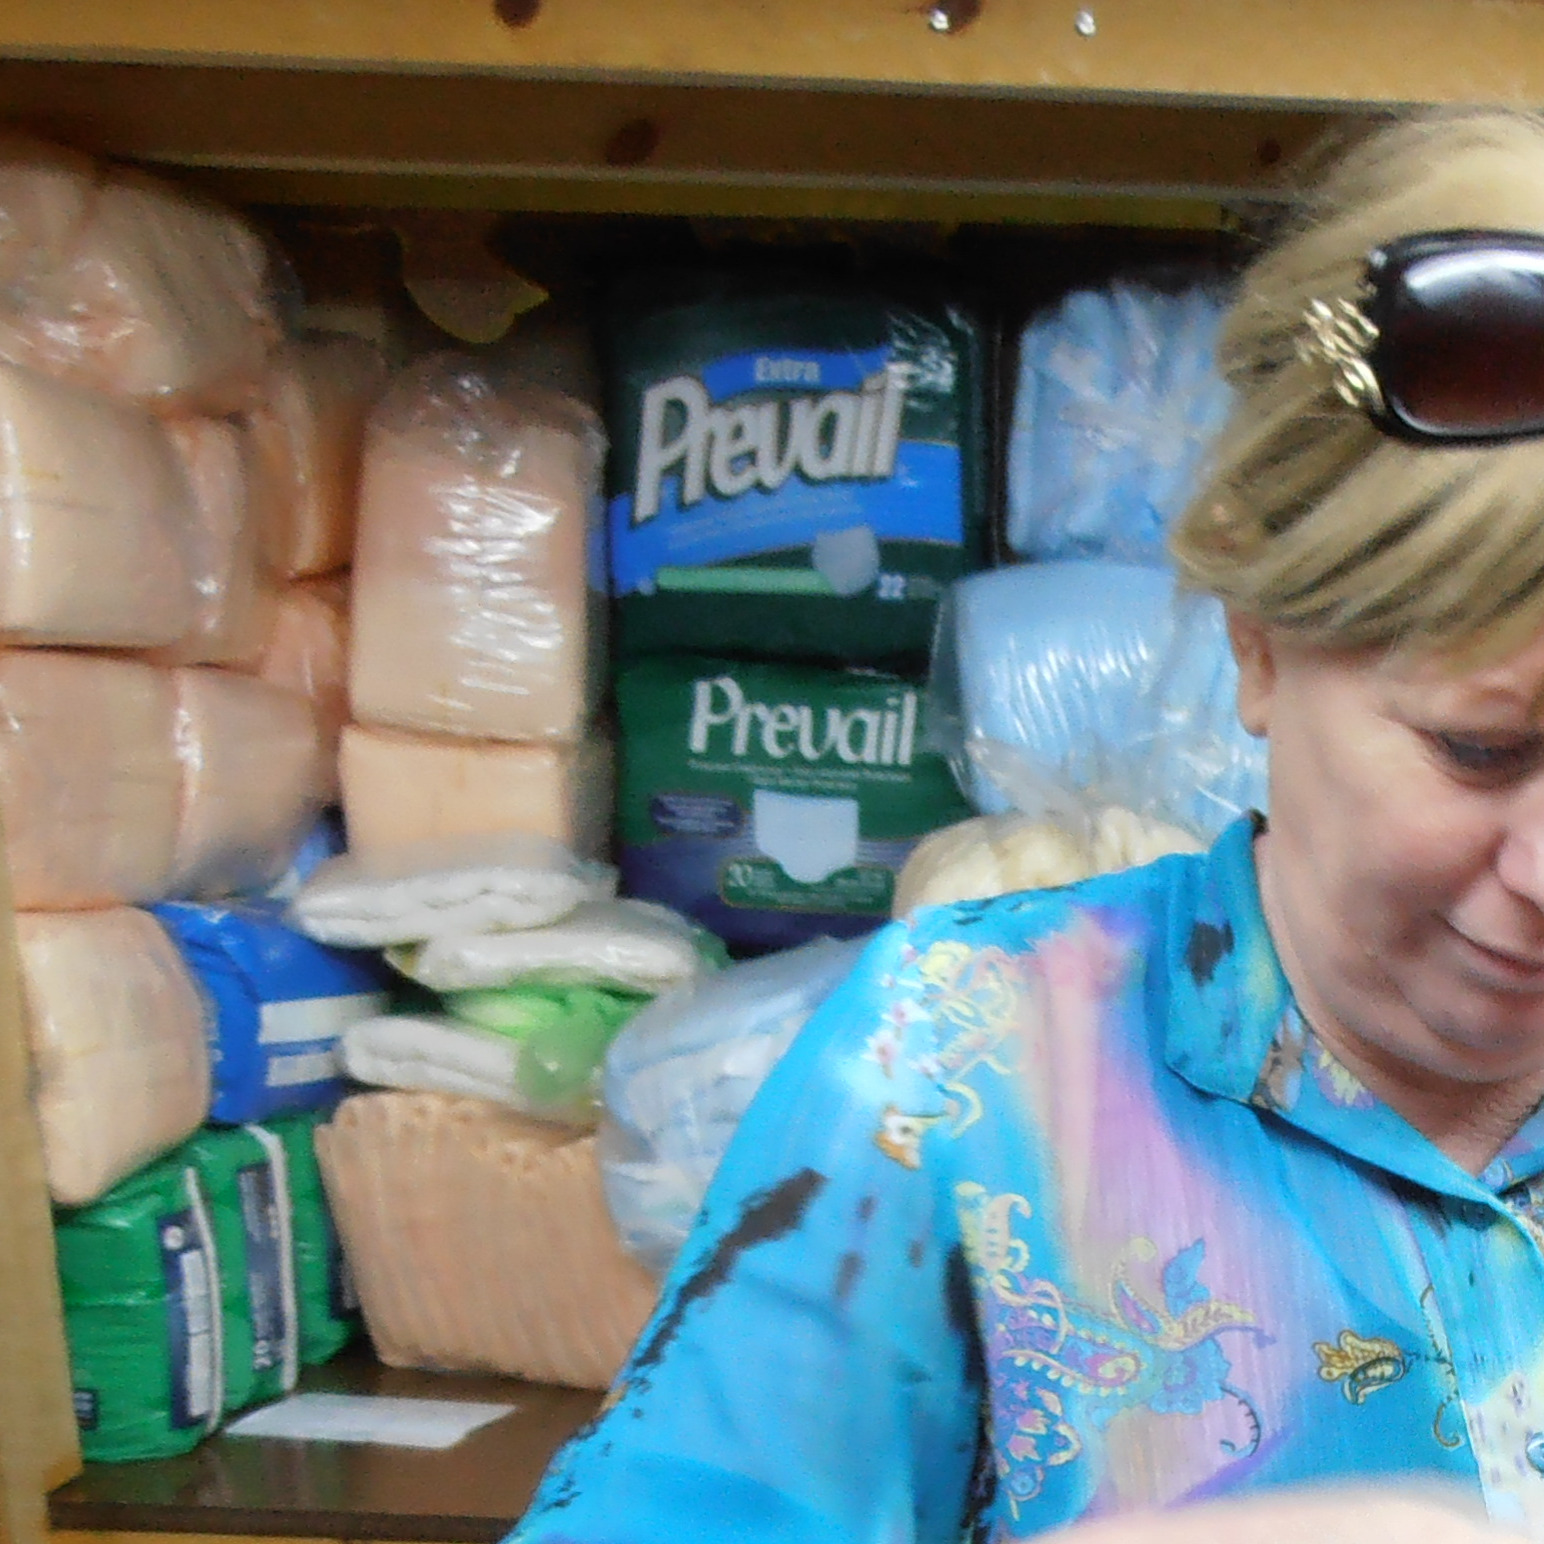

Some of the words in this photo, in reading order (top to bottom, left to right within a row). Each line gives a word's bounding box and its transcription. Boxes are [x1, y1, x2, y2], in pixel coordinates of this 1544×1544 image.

[754, 357, 822, 383] Extra
[634, 369, 905, 525] Prevail
[689, 676, 917, 766] Prevail
